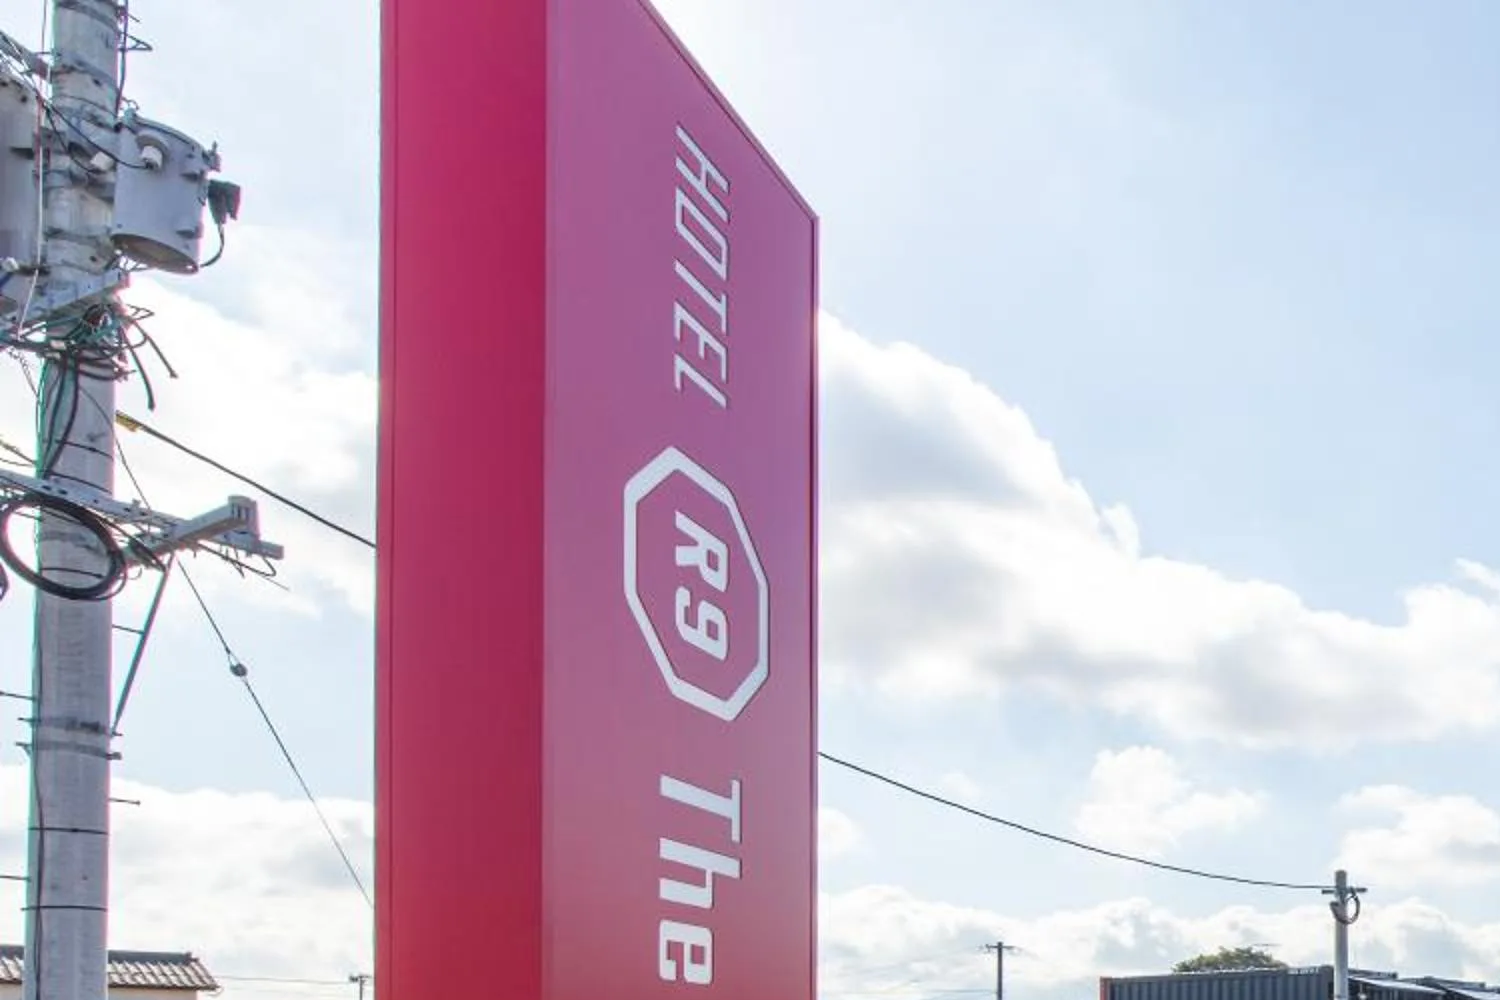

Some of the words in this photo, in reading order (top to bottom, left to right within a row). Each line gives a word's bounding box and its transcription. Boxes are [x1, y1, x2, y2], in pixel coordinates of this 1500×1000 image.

[674, 122, 730, 409] HOTEL
[675, 510, 728, 660] R9
[659, 774, 741, 984] The
